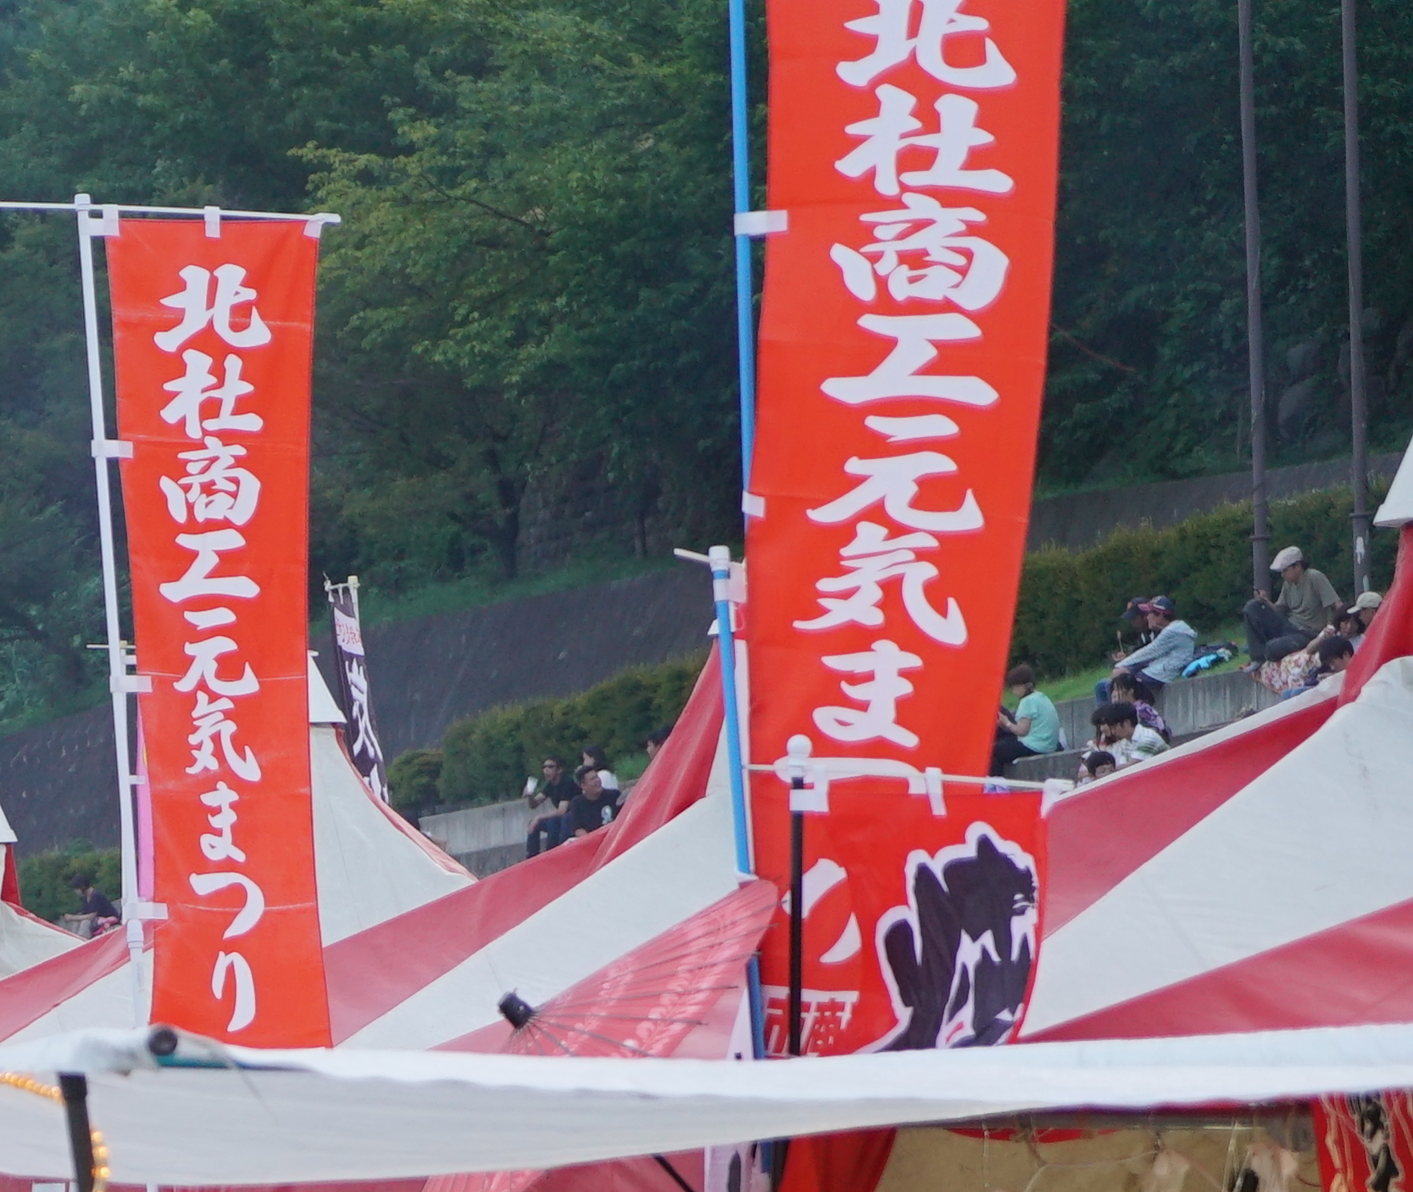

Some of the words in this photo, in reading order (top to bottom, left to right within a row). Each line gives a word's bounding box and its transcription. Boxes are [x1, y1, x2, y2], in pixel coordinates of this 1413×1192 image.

[154, 263, 272, 1032] 北杜商工元気まつり
